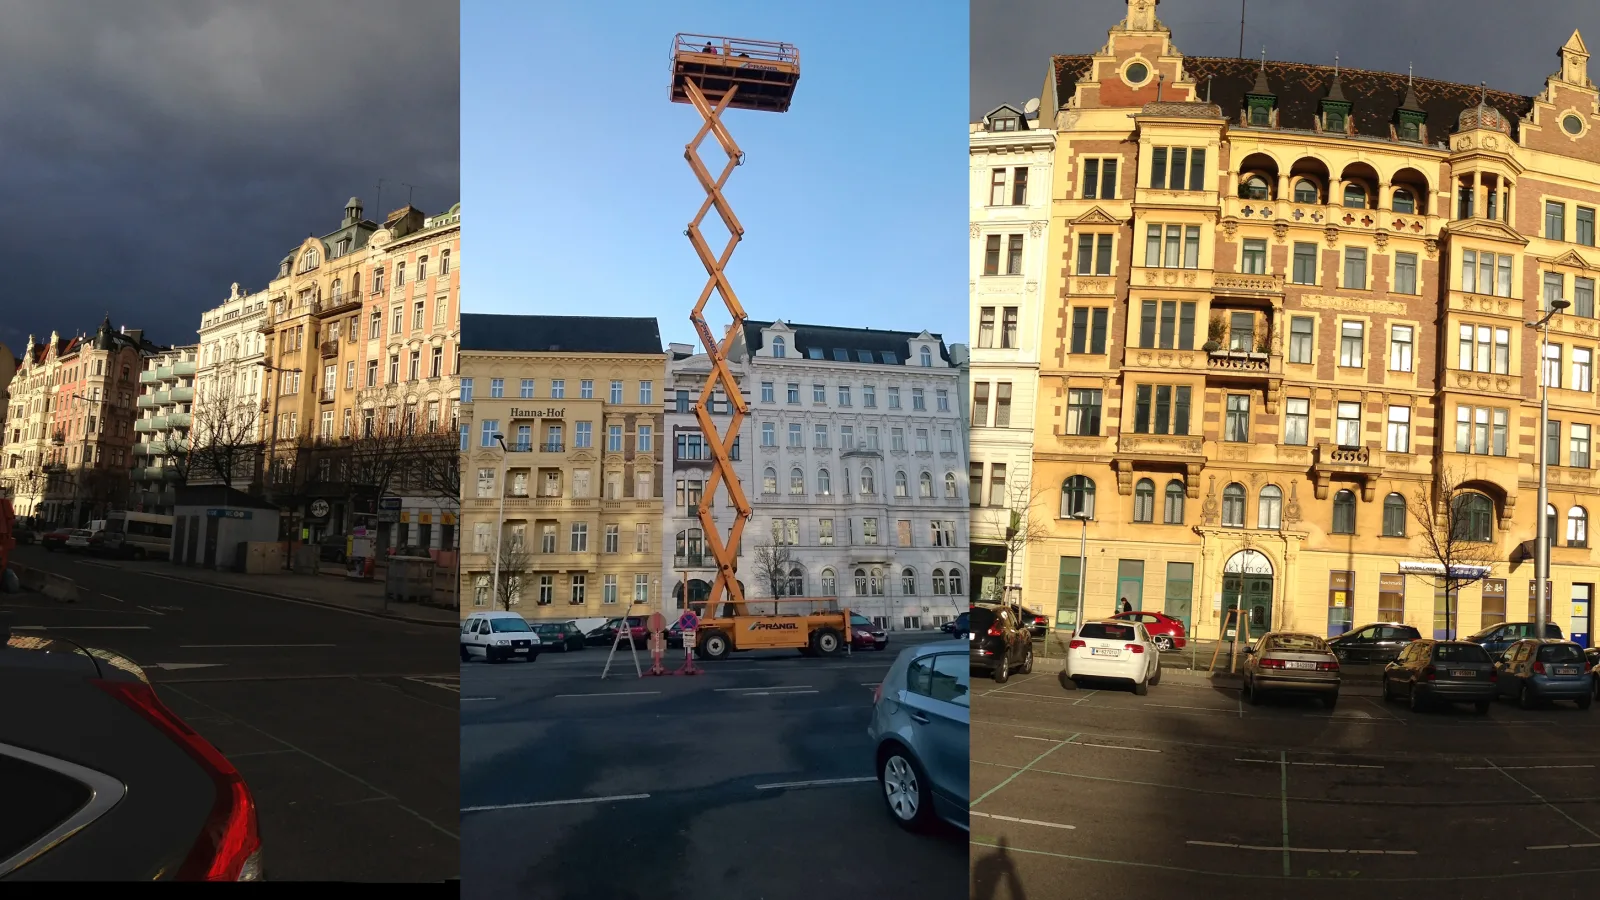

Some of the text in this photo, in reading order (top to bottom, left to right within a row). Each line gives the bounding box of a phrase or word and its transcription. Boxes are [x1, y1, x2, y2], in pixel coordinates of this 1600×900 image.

[701, 322, 719, 356] PRANGL
[510, 407, 566, 418] Hanna-Hof
[1483, 582, 1504, 593] 金融
[758, 622, 799, 630] PRANGL
